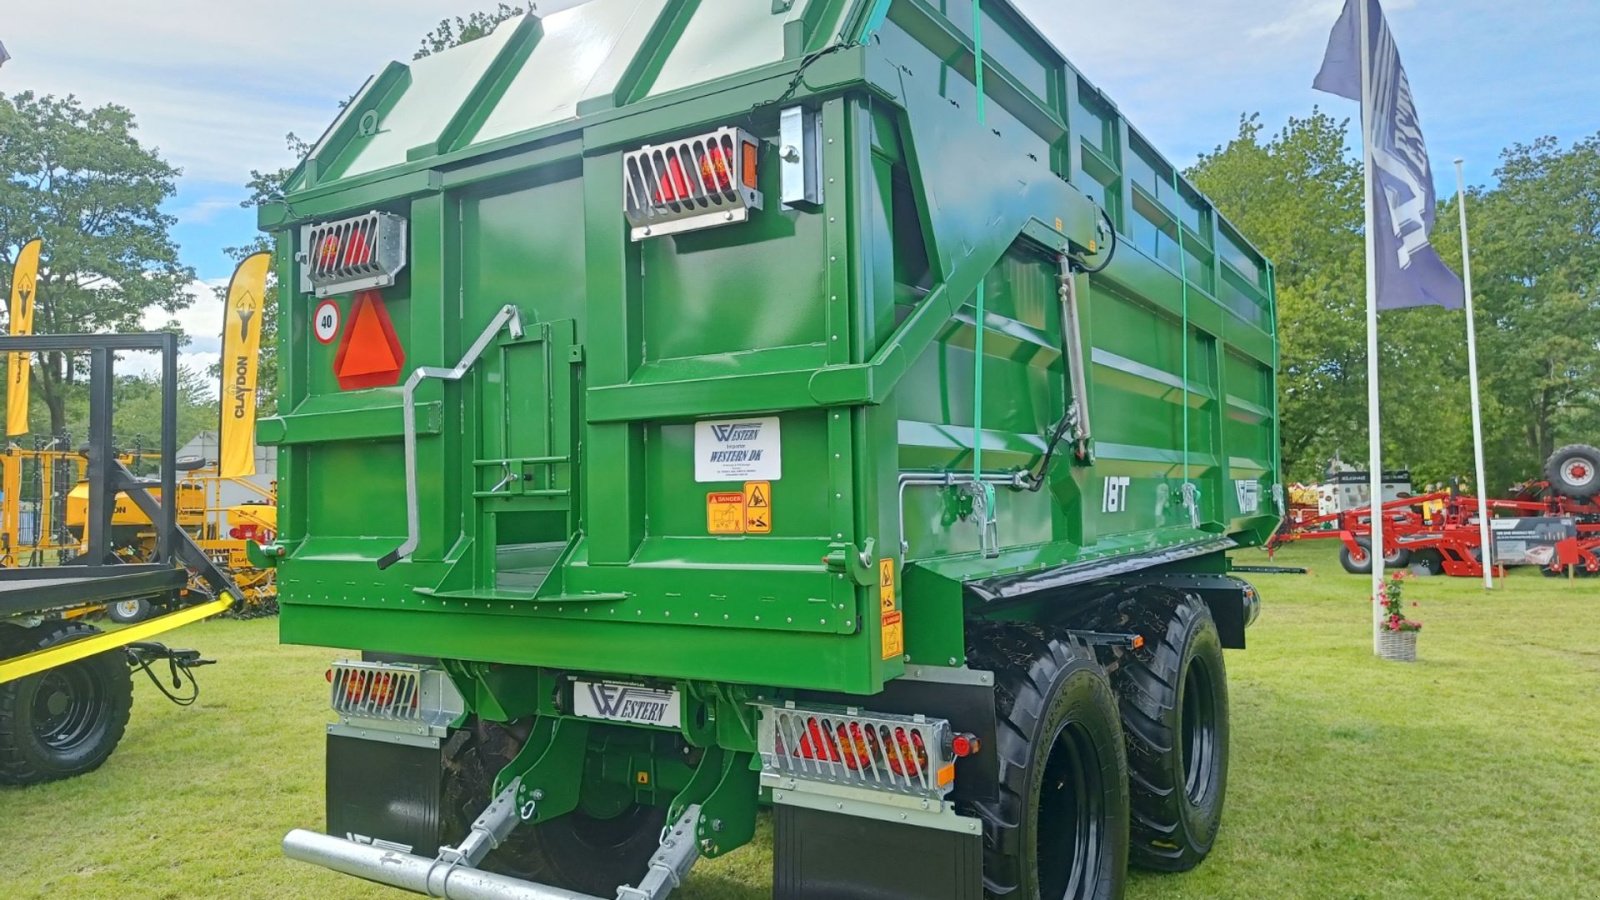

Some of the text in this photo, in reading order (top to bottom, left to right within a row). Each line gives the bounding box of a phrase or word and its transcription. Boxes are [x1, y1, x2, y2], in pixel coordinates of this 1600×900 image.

[321, 314, 332, 329] 40
[234, 356, 252, 419] CLAYDON
[710, 423, 762, 442] WESTERN
[709, 449, 763, 462] WESTERN DK
[588, 684, 673, 722] WESTERN
